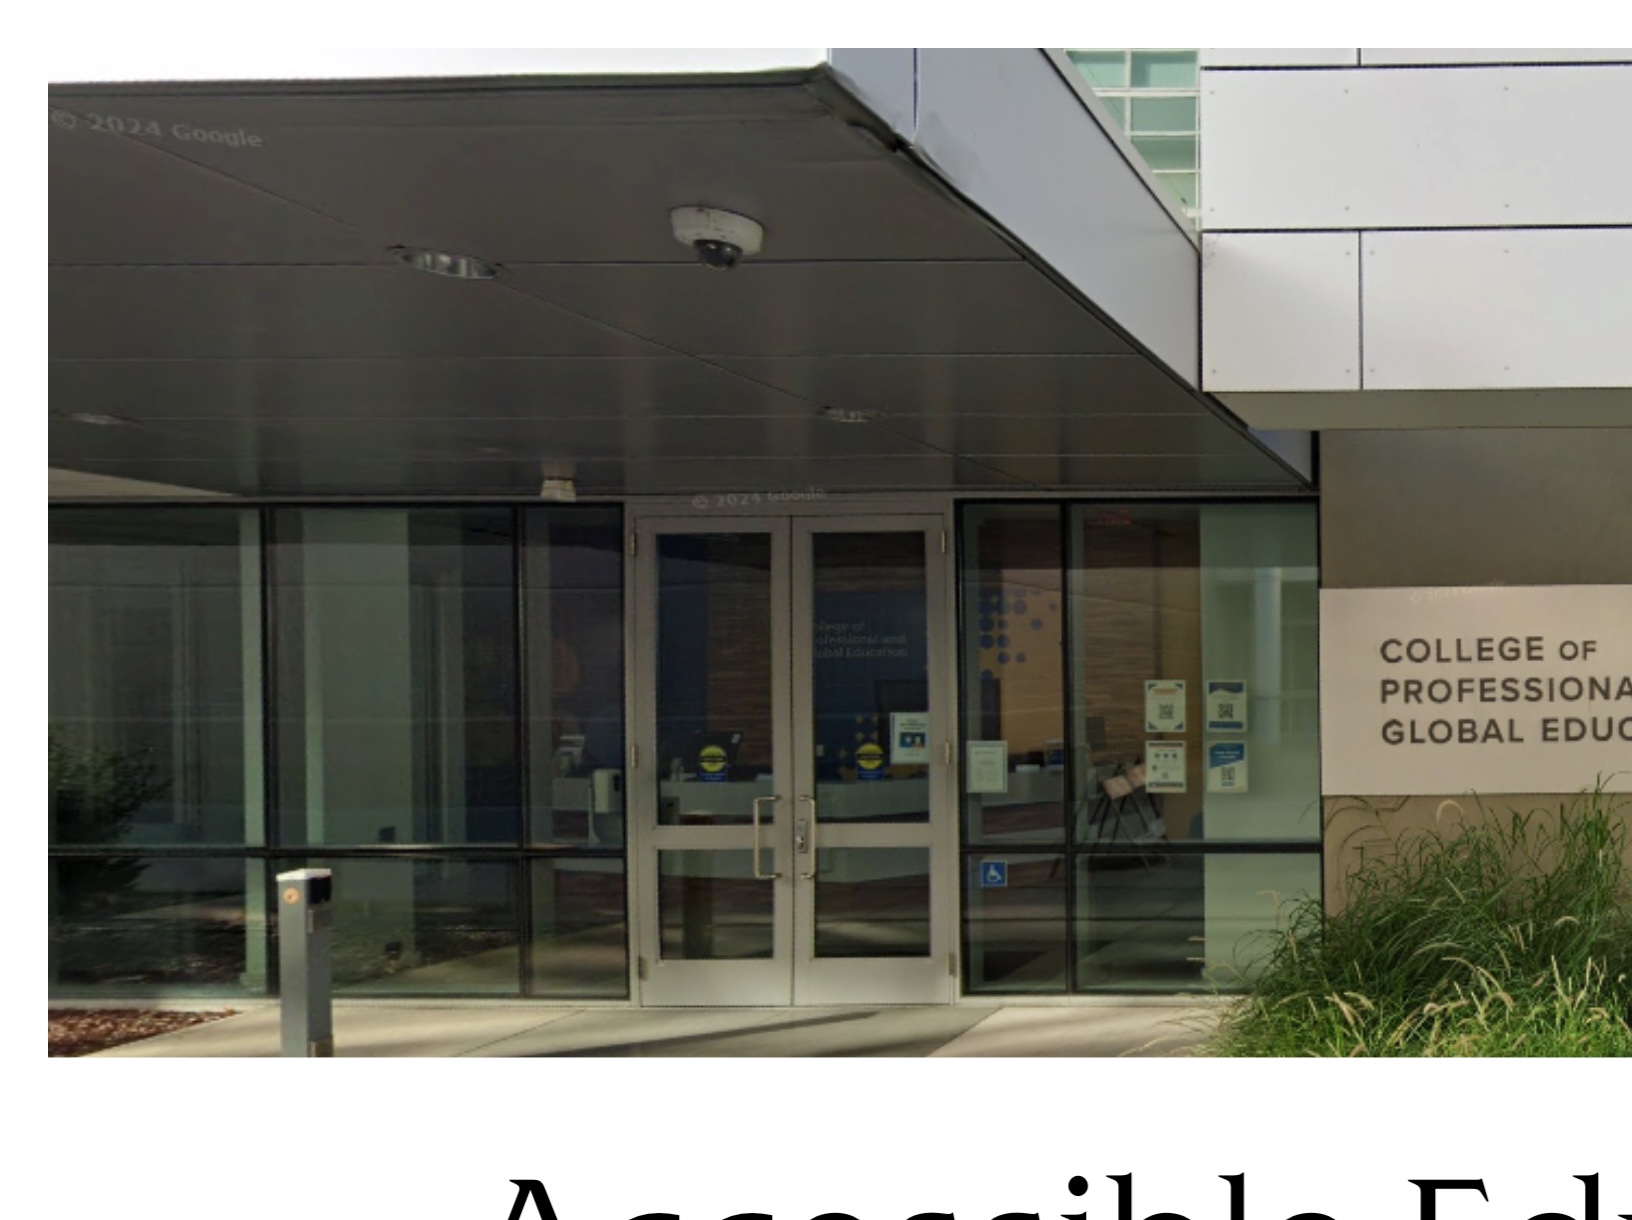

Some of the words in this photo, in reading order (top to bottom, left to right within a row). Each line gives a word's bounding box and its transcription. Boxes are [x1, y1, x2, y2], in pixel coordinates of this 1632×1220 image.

[1379, 636, 1545, 664] COLLEGE
[1559, 640, 1598, 661] OF
[1381, 718, 1525, 746] GLOBAL
